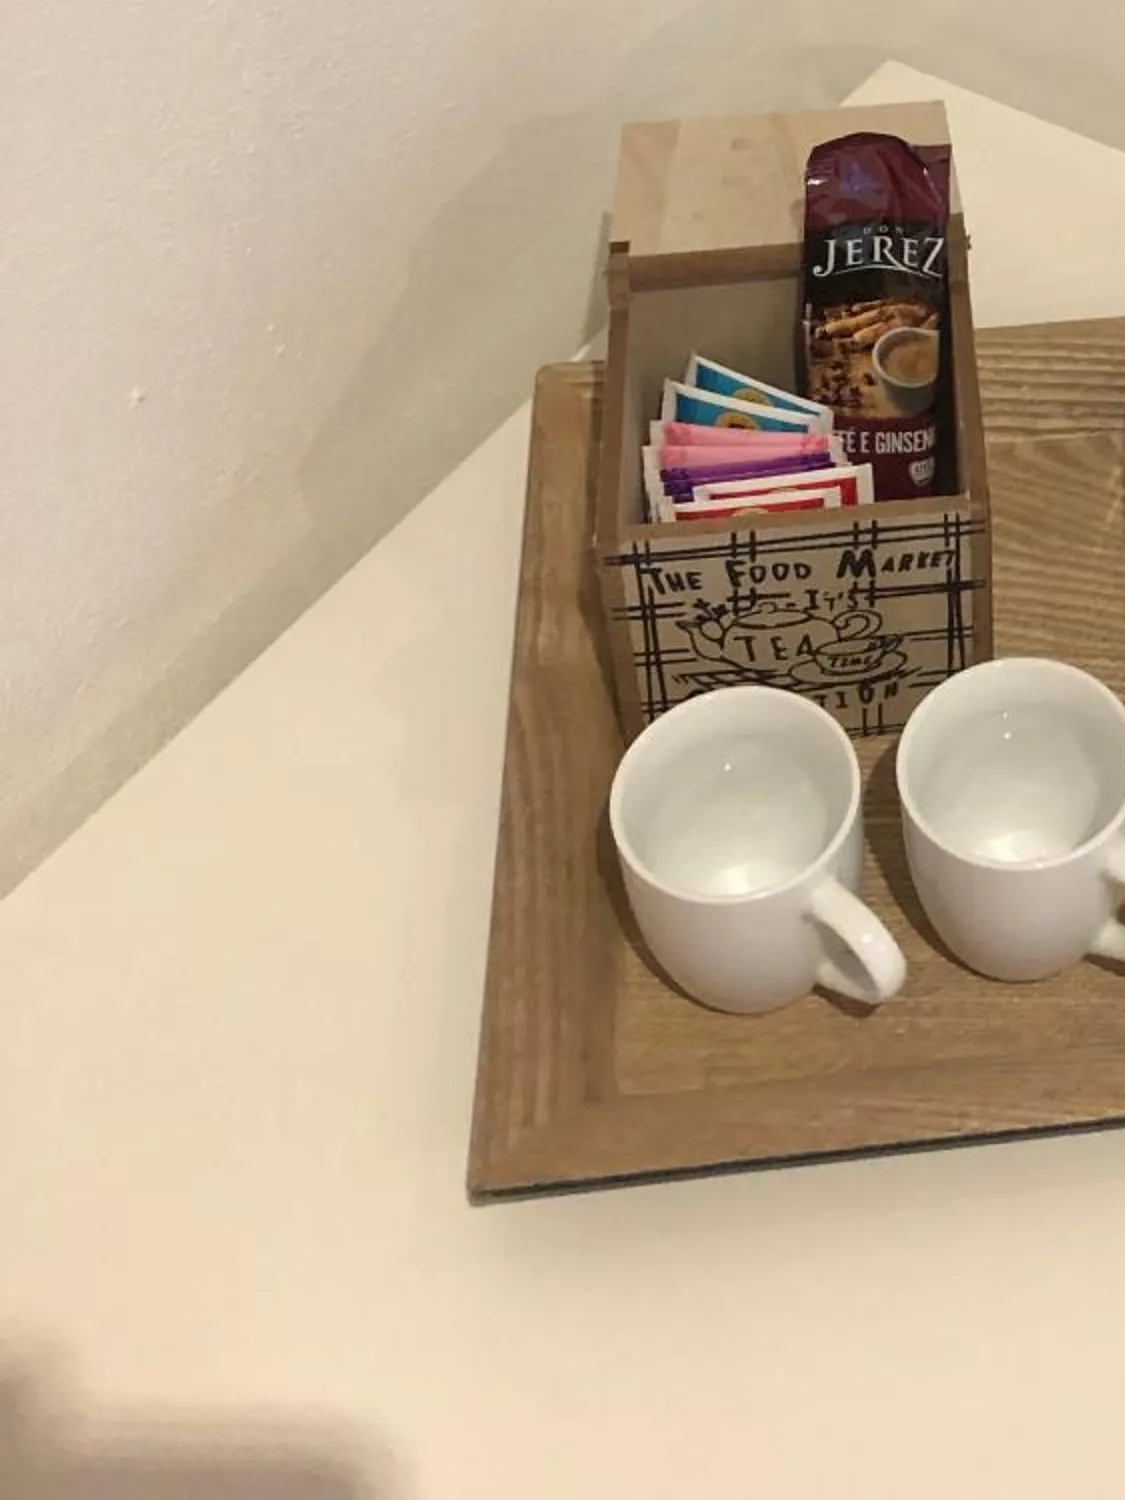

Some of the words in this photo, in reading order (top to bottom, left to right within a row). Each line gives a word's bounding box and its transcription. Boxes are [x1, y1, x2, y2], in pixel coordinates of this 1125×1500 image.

[812, 235, 945, 278] JEREZ
[874, 428, 936, 455] GINSEN
[641, 566, 703, 595] THE
[724, 559, 812, 588] FOOD
[836, 548, 955, 579] MARKET
[732, 633, 818, 663] TEA
